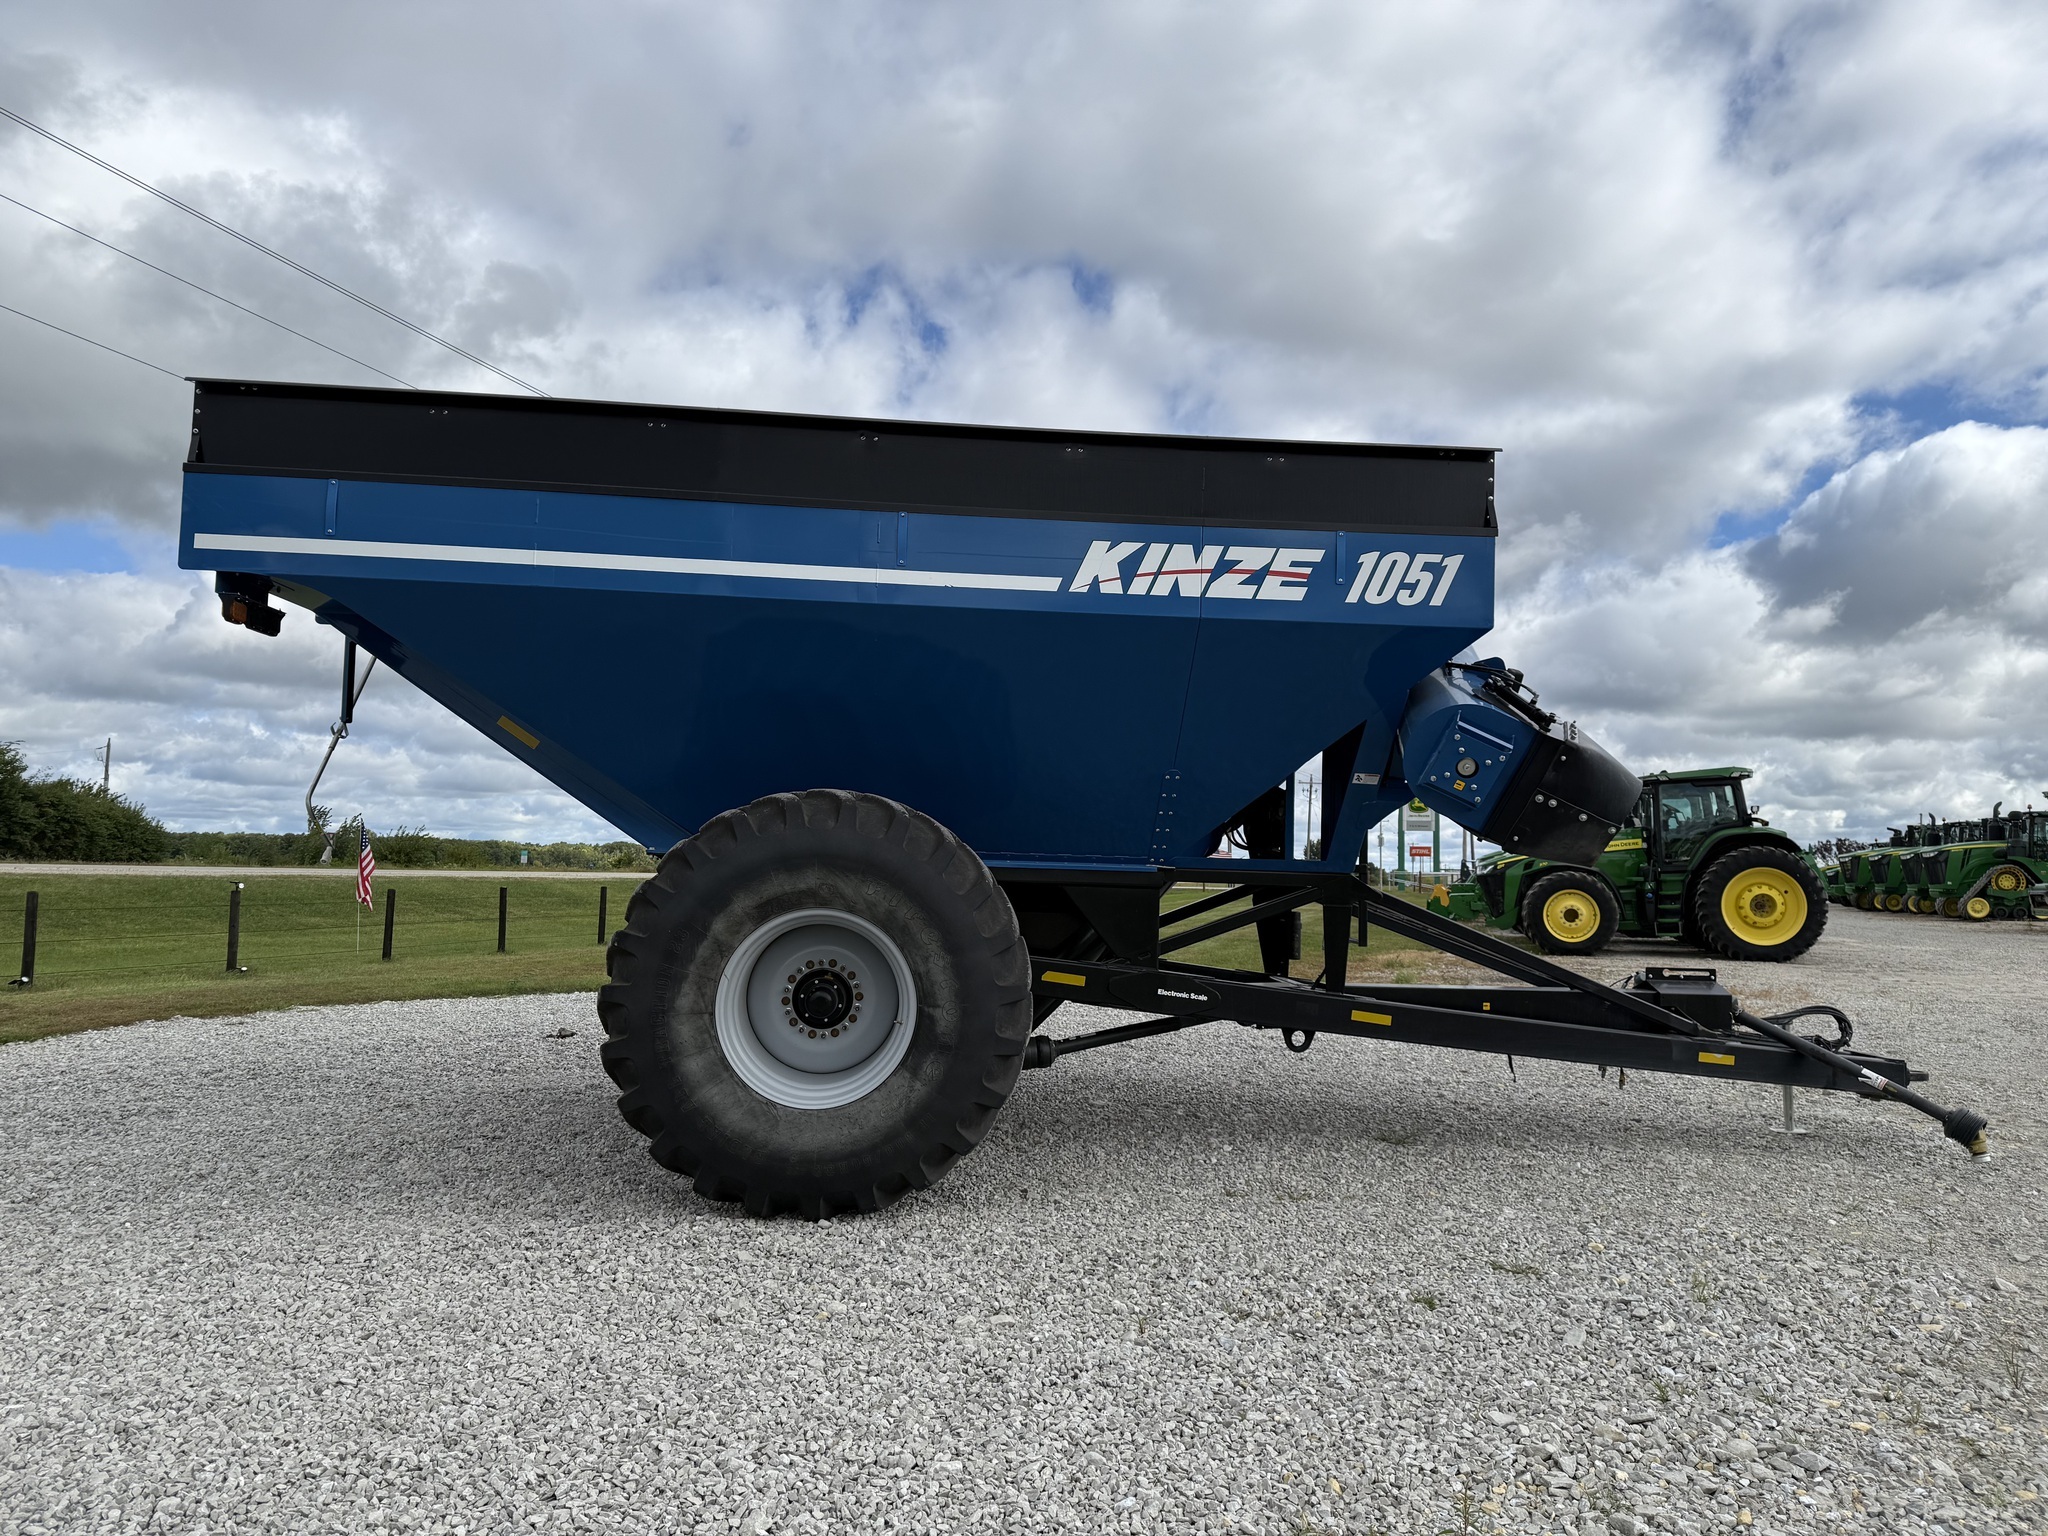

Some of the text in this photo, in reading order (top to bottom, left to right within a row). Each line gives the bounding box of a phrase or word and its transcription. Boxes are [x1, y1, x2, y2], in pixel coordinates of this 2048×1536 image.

[1068, 540, 1464, 606] KINZE 1051
[1157, 988, 1208, 1001] Electronic Scale
